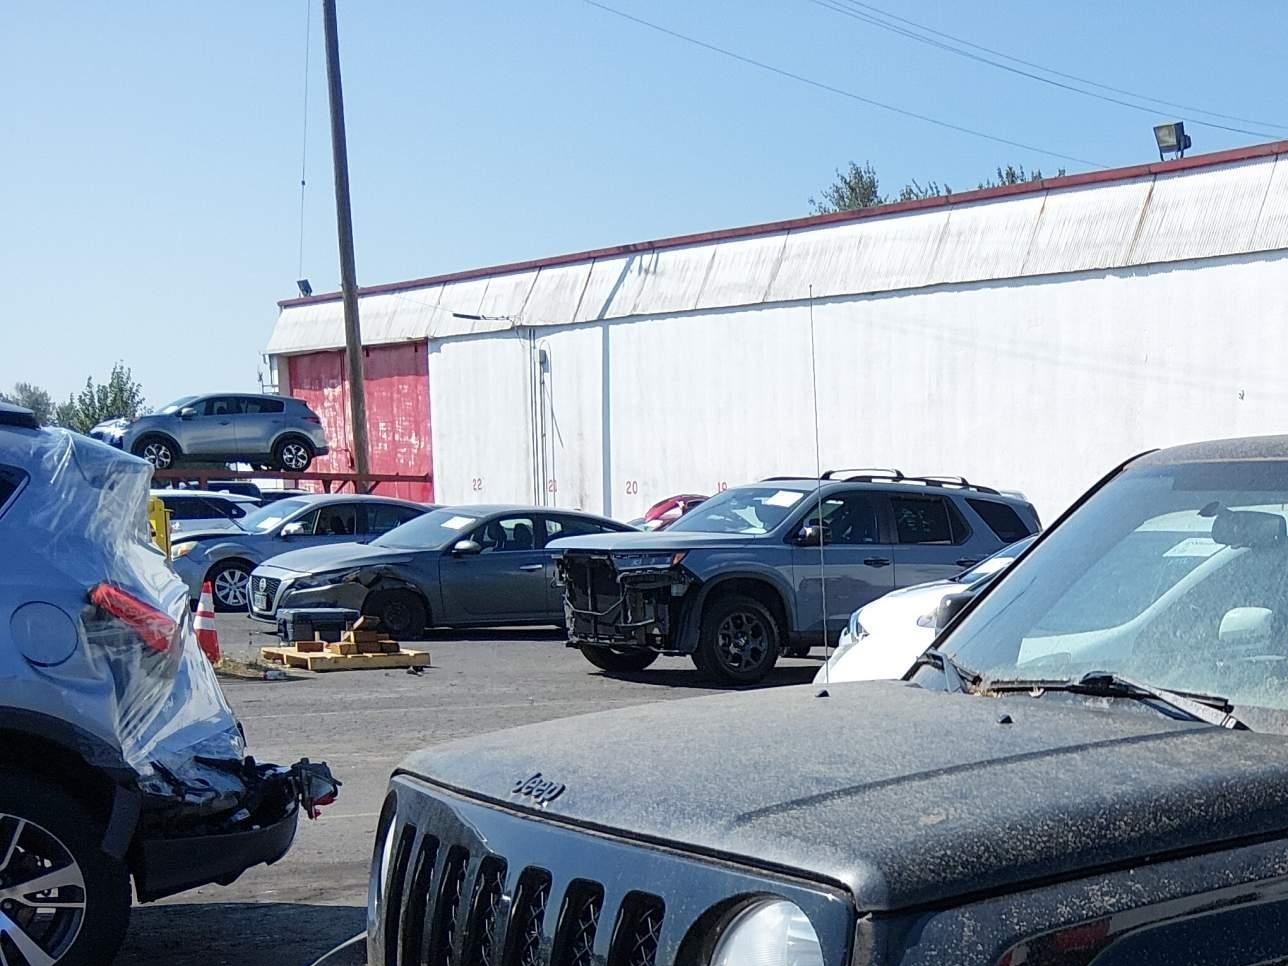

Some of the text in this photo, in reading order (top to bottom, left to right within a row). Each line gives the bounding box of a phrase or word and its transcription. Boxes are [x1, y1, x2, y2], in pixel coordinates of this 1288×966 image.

[472, 478, 482, 491] 22
[625, 480, 638, 495] 20
[512, 772, 566, 804] Jeep
